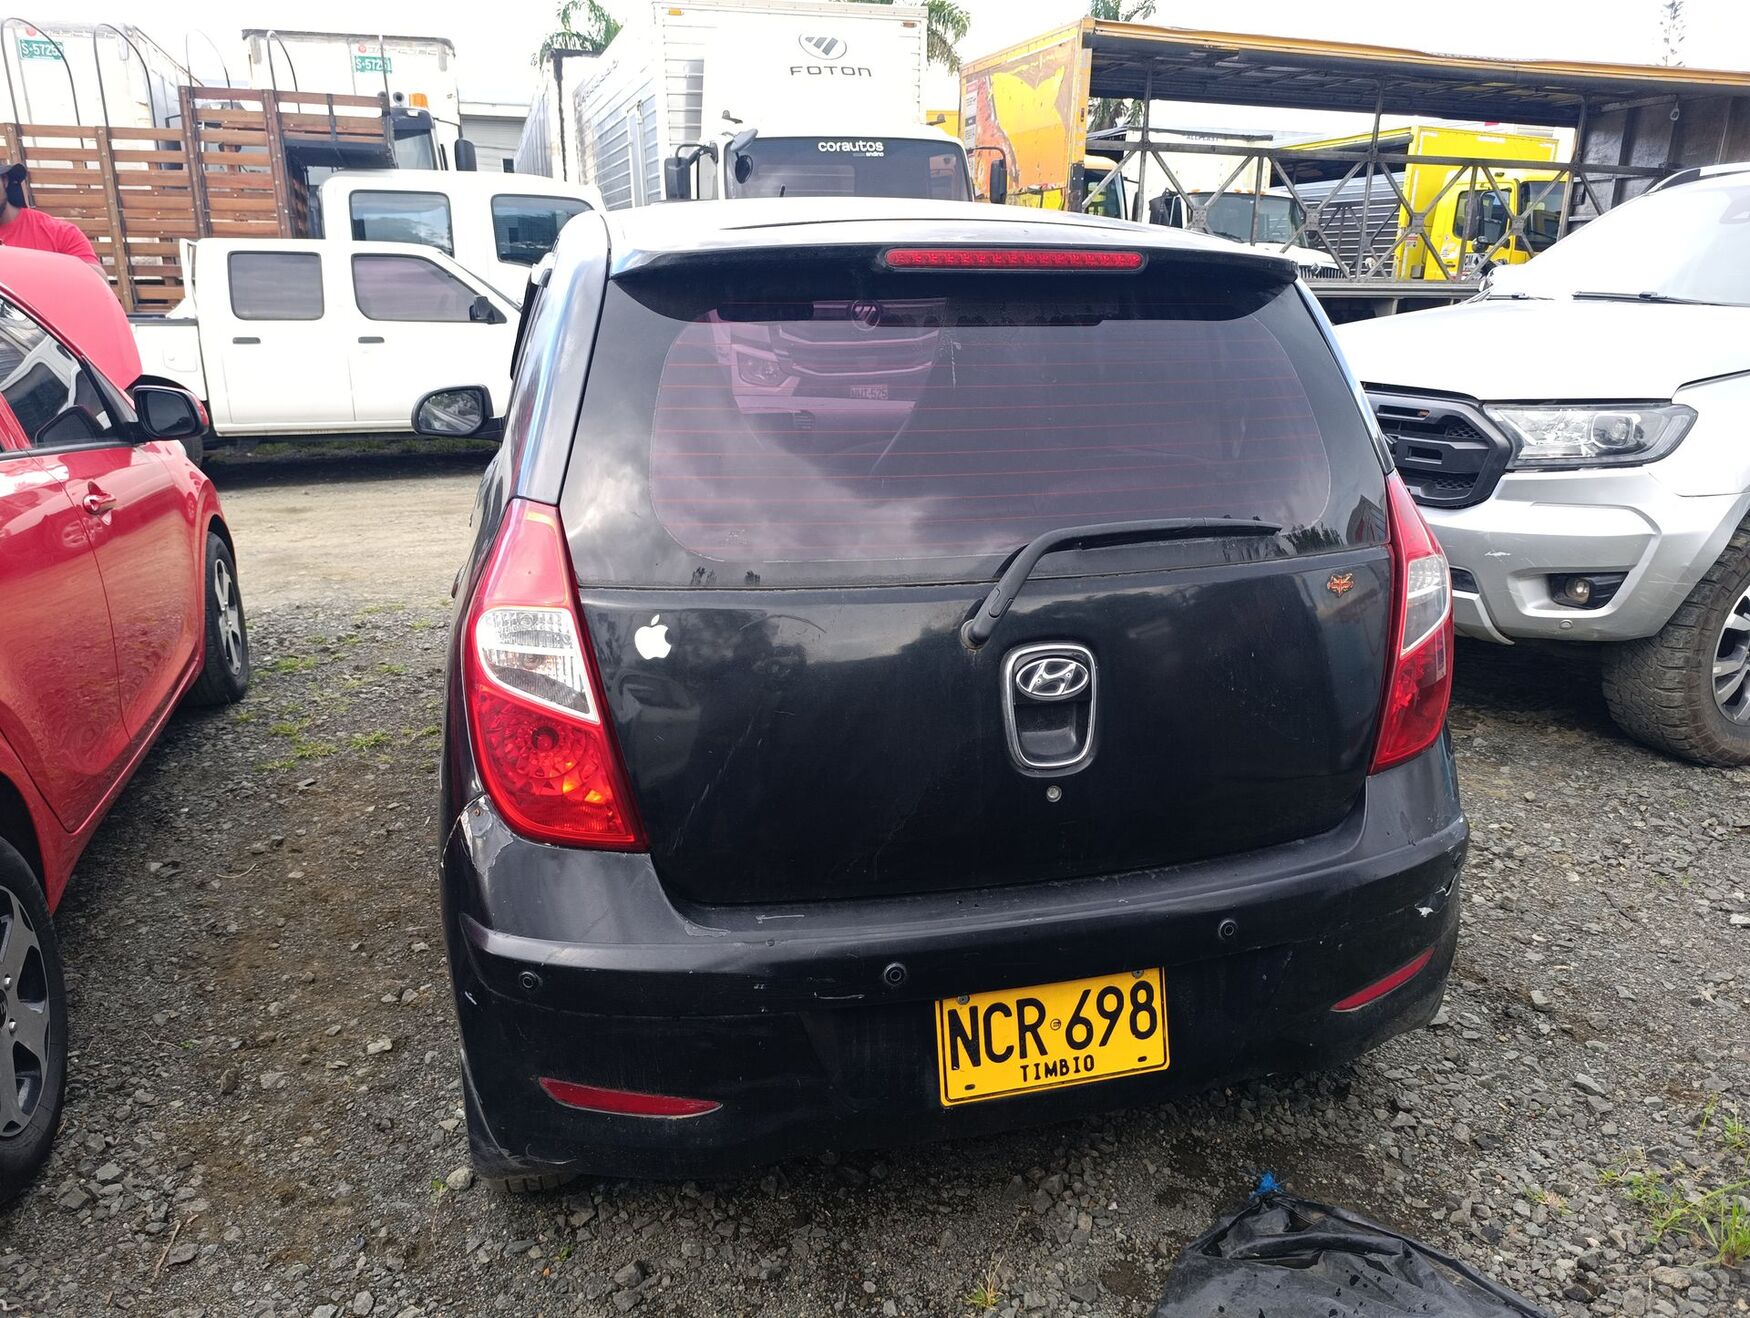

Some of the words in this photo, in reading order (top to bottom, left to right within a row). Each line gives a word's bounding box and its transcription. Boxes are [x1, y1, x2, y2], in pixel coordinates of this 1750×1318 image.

[790, 66, 872, 77] FOTON
[818, 140, 884, 152] corautos
[947, 997, 1049, 1071] NCR
[1065, 980, 1158, 1051] 698
[1020, 1054, 1096, 1082] TIMBIO
